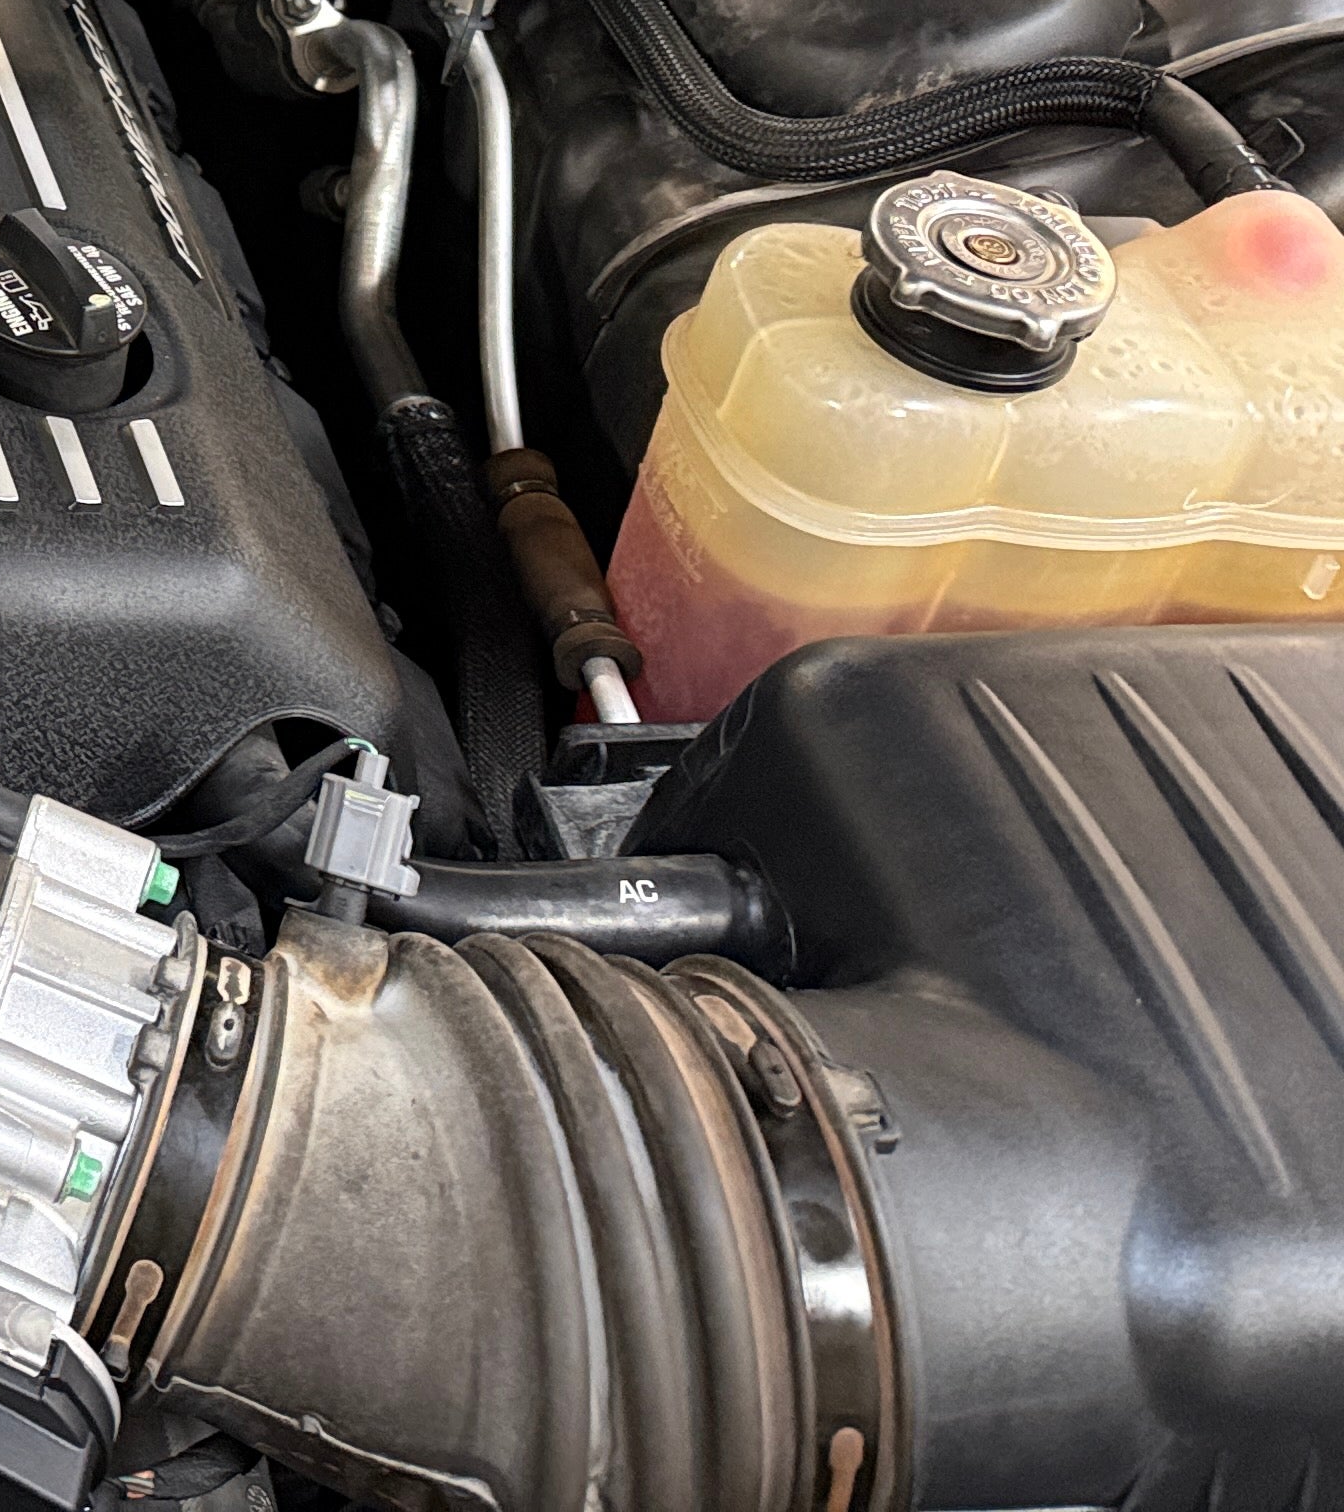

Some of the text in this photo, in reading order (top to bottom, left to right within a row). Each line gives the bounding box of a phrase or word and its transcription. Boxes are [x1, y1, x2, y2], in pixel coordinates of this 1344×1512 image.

[893, 182, 958, 212] TIGHT
[115, 284, 144, 307] SAE
[619, 879, 659, 904] AC
